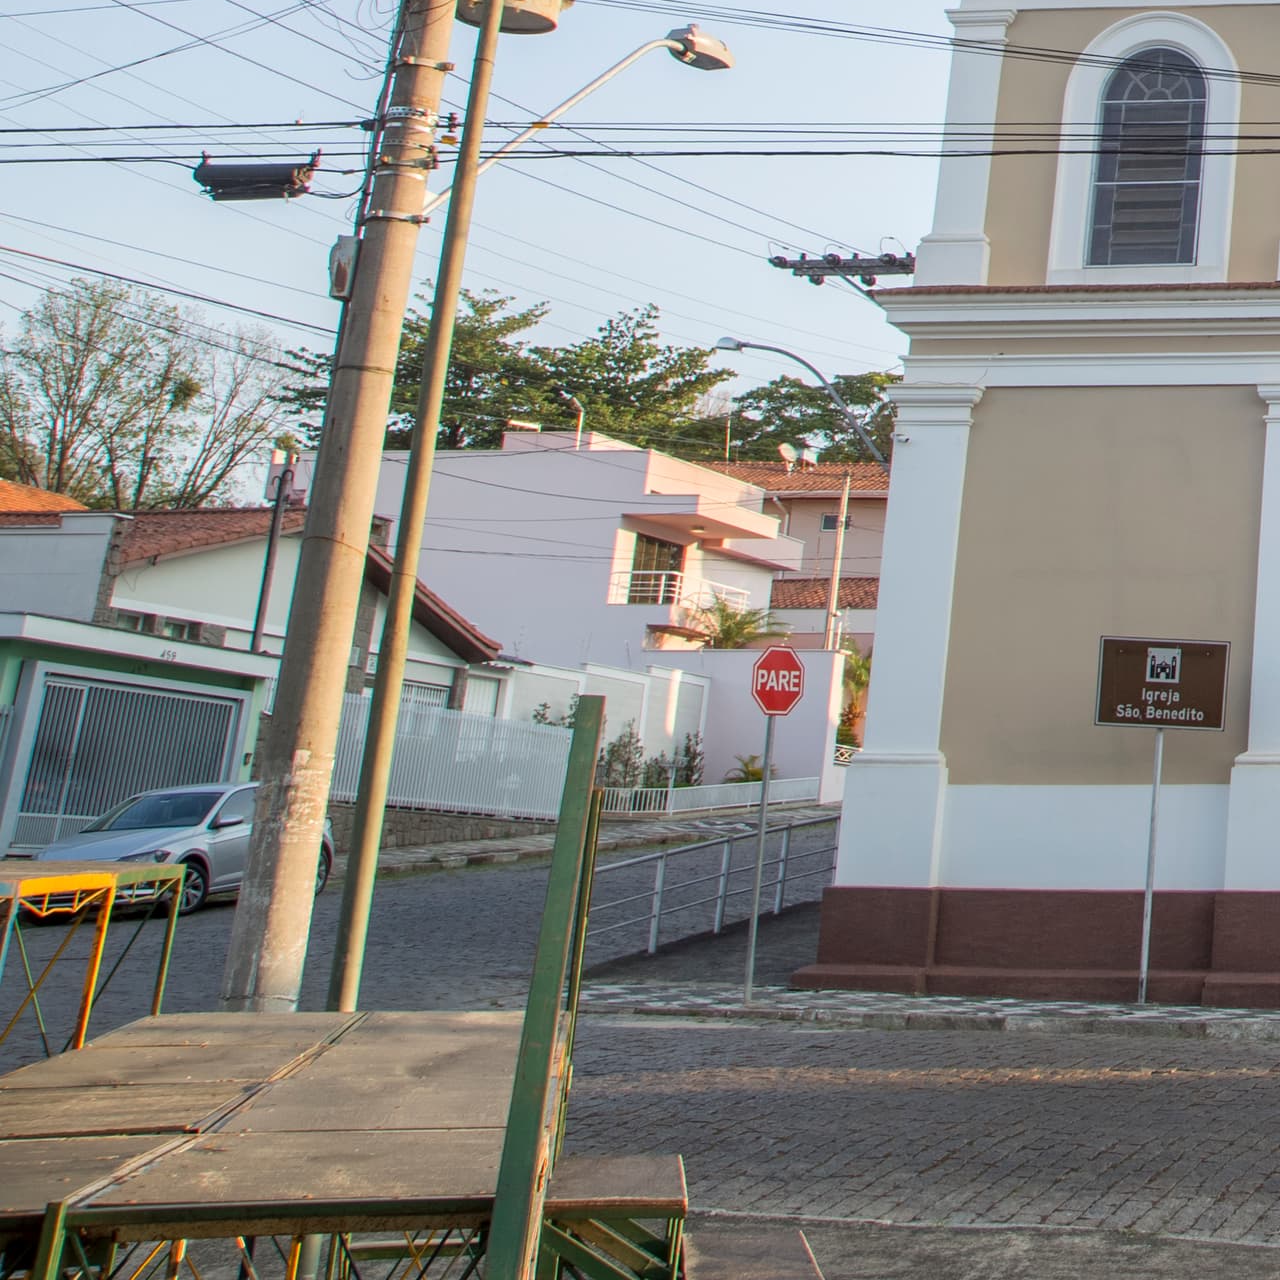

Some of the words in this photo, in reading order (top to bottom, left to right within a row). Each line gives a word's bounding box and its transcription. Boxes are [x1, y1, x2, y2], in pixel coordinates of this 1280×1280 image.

[757, 669, 801, 692] PARE
[1141, 687, 1180, 705] Igreja
[1116, 704, 1140, 719] São
[1145, 706, 1204, 721] Benedito
